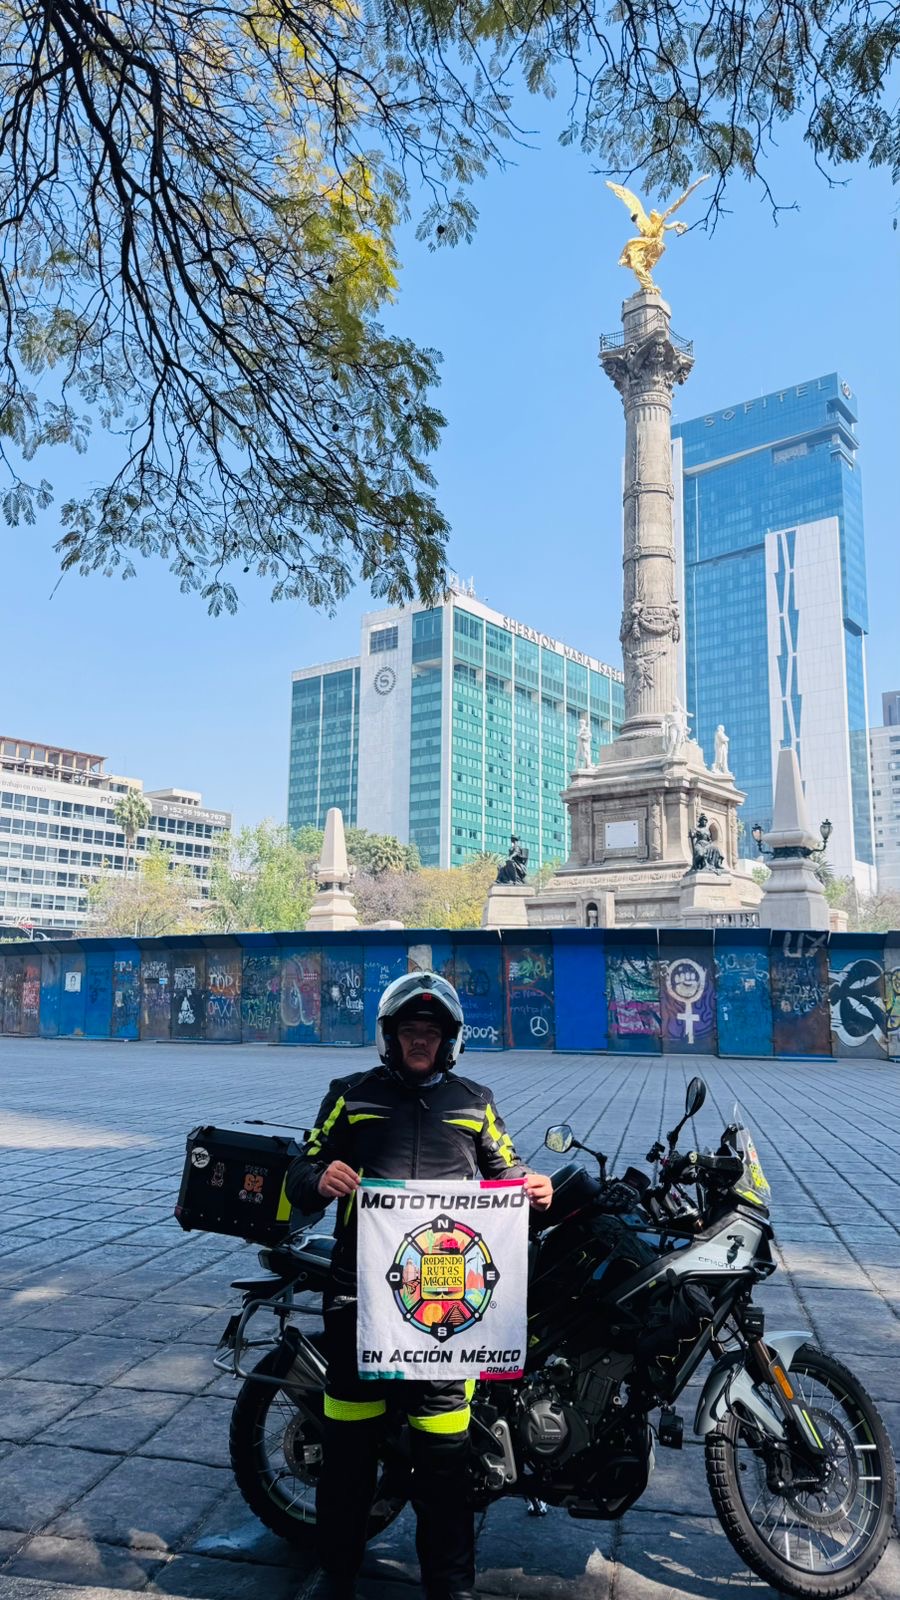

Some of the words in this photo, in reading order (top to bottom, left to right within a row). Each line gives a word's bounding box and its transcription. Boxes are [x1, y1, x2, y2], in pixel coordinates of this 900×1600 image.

[704, 379, 830, 428] SOFITEL
[502, 616, 556, 650] SHERATON
[563, 645, 592, 667] MARIA
[437, 1219, 449, 1229] N
[389, 1272, 400, 1282] O
[486, 1271, 496, 1281] E
[437, 1327, 448, 1337] S
[362, 1350, 382, 1363] EN
[389, 1345, 453, 1364] ACCIÓN
[460, 1345, 521, 1364] MÉXICO
